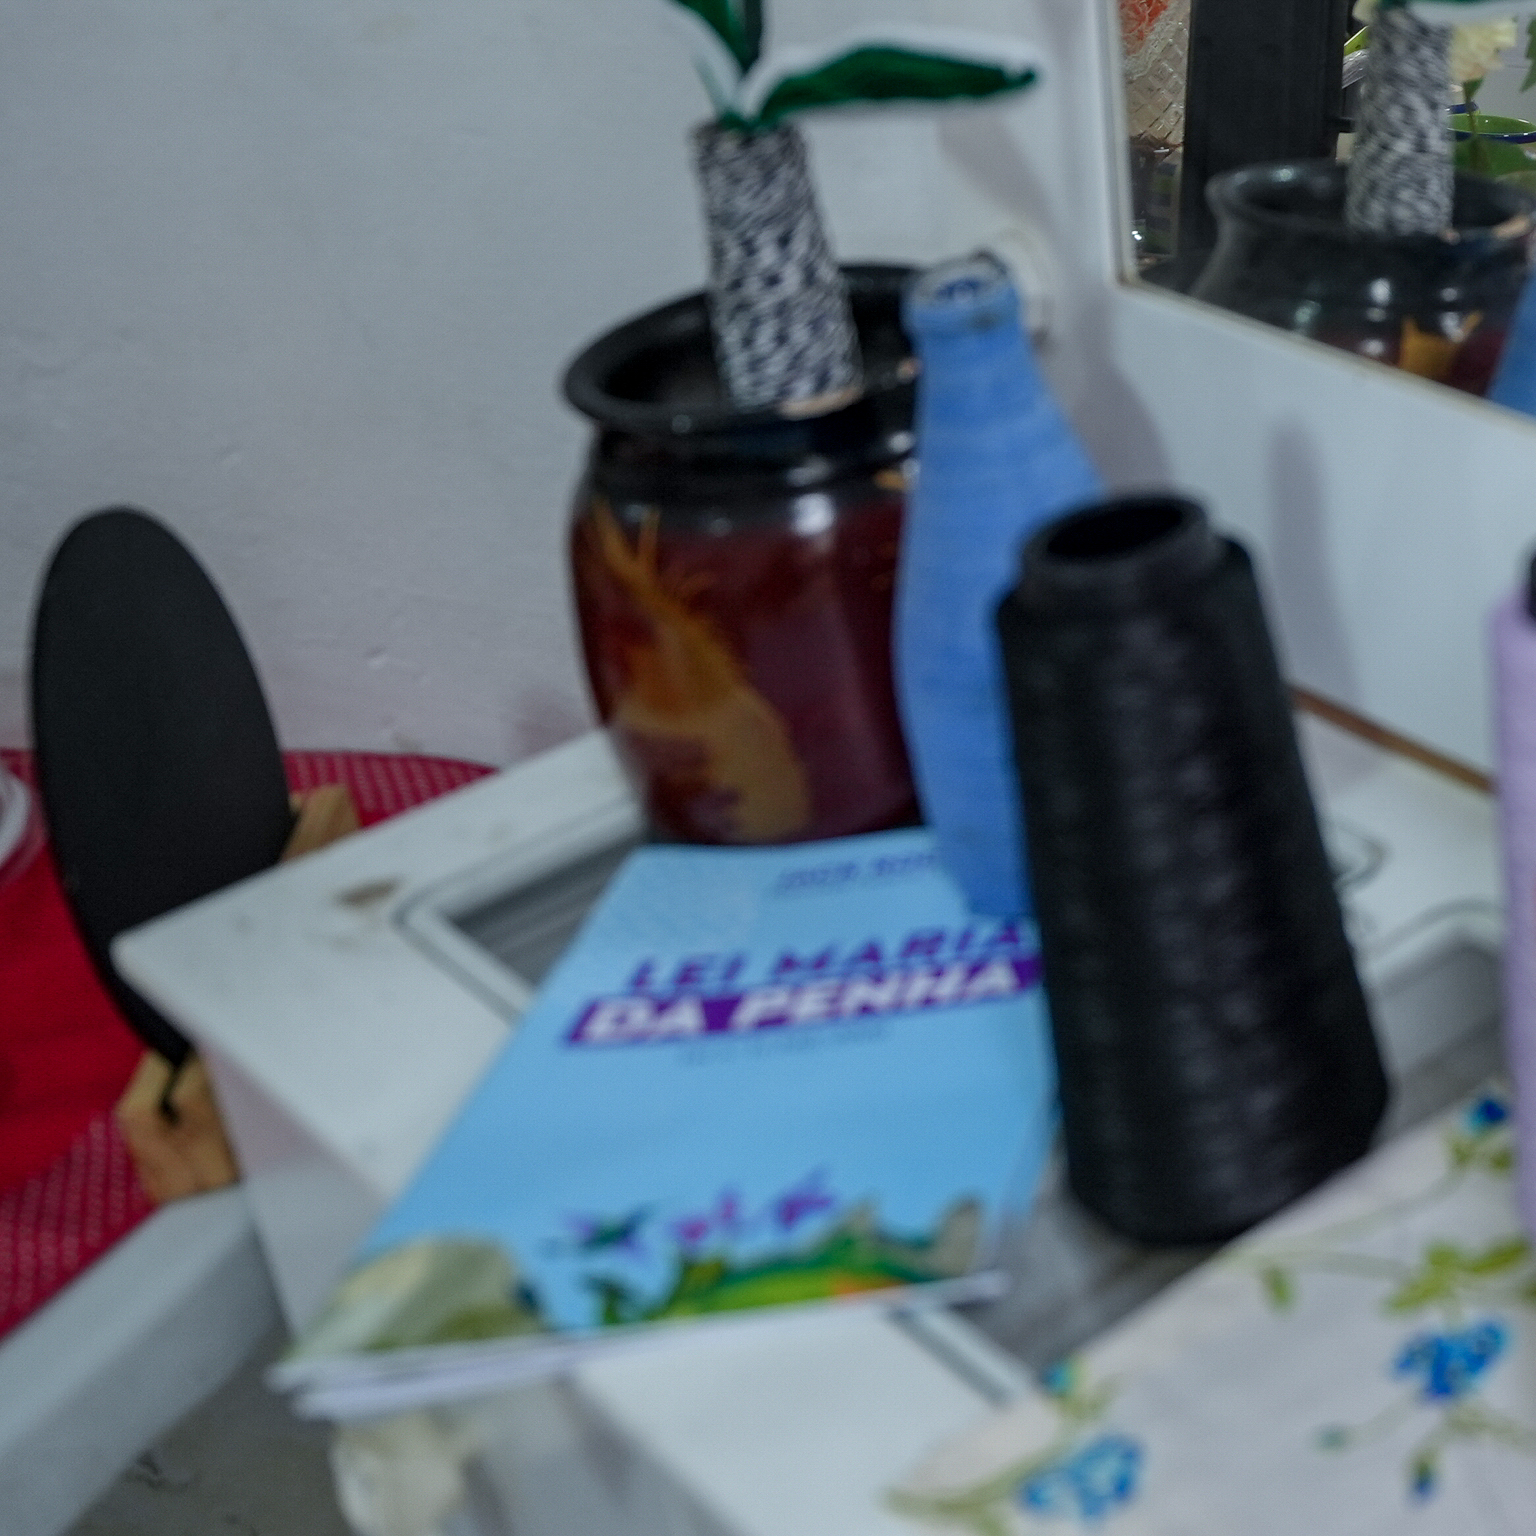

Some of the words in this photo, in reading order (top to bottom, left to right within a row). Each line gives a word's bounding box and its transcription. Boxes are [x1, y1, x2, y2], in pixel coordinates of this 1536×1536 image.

[628, 956, 745, 995] LEI
[772, 921, 1025, 978] MARIA
[586, 999, 704, 1042] DA
[733, 958, 1022, 1031] PENHA
